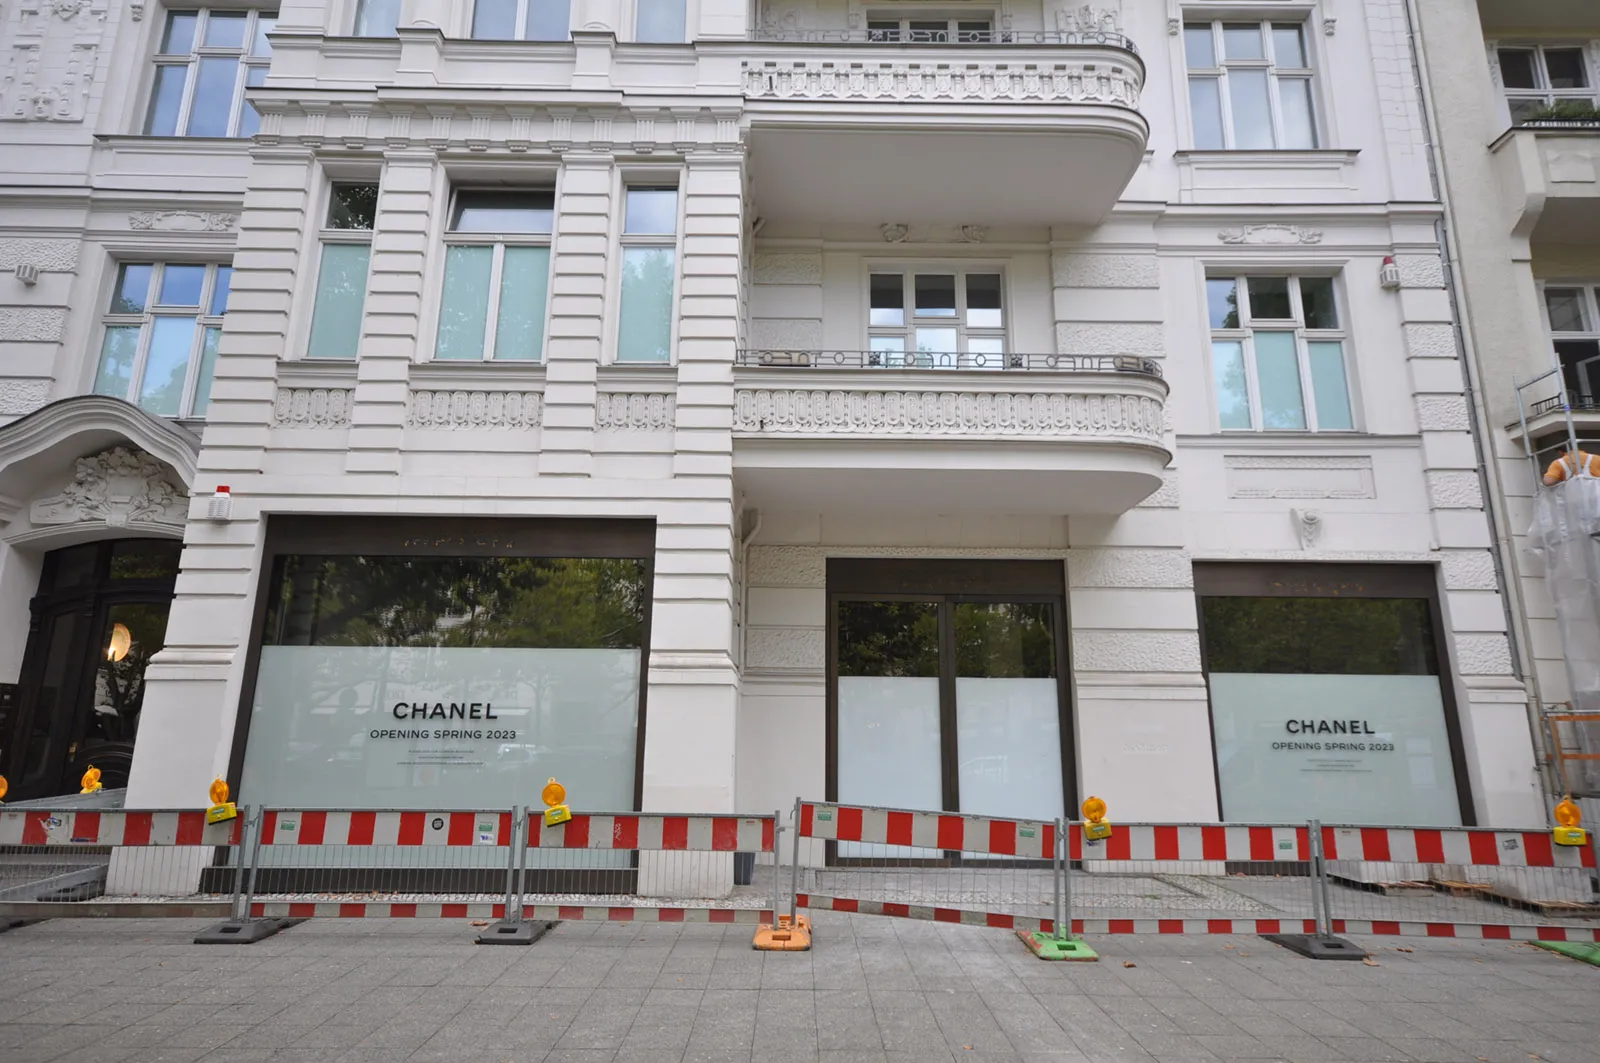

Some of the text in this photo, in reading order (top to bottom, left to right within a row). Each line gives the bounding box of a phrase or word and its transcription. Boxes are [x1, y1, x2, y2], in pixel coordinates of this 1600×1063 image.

[393, 702, 498, 720] CHANEL
[1286, 719, 1375, 734] CHANEL
[370, 729, 517, 739] OPENING SPRING 2023
[1272, 742, 1394, 751] OPENING SPRING 2023
